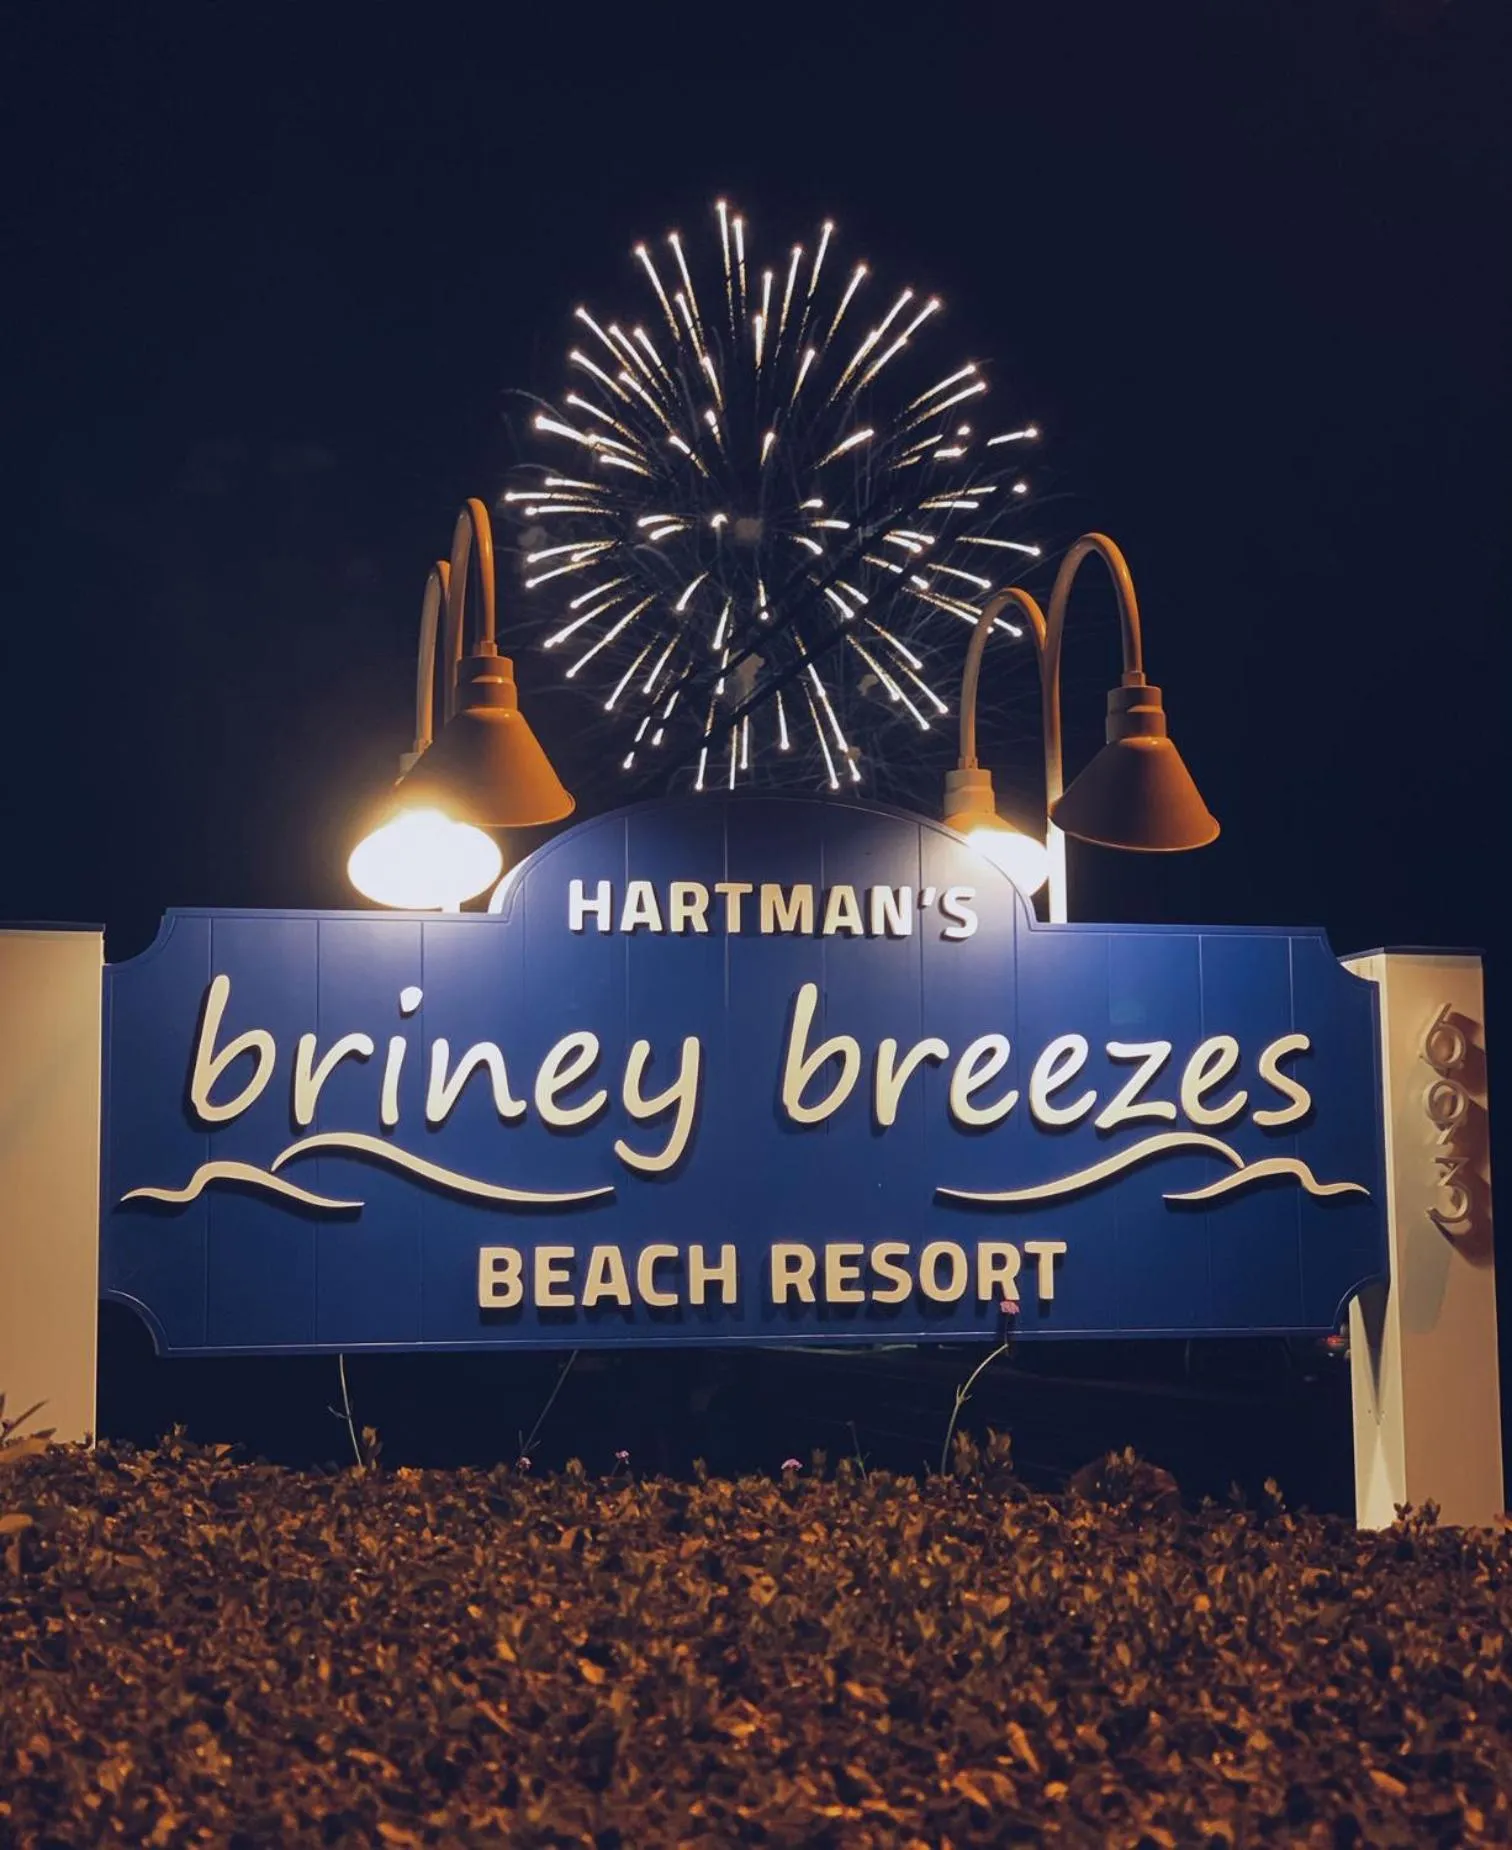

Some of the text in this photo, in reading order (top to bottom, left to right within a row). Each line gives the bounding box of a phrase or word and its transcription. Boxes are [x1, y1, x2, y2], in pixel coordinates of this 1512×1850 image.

[568, 878, 979, 940] HARTMAN'S
[190, 974, 1312, 1171] briney breezes
[477, 1240, 1067, 1308] BEACH RESORT
